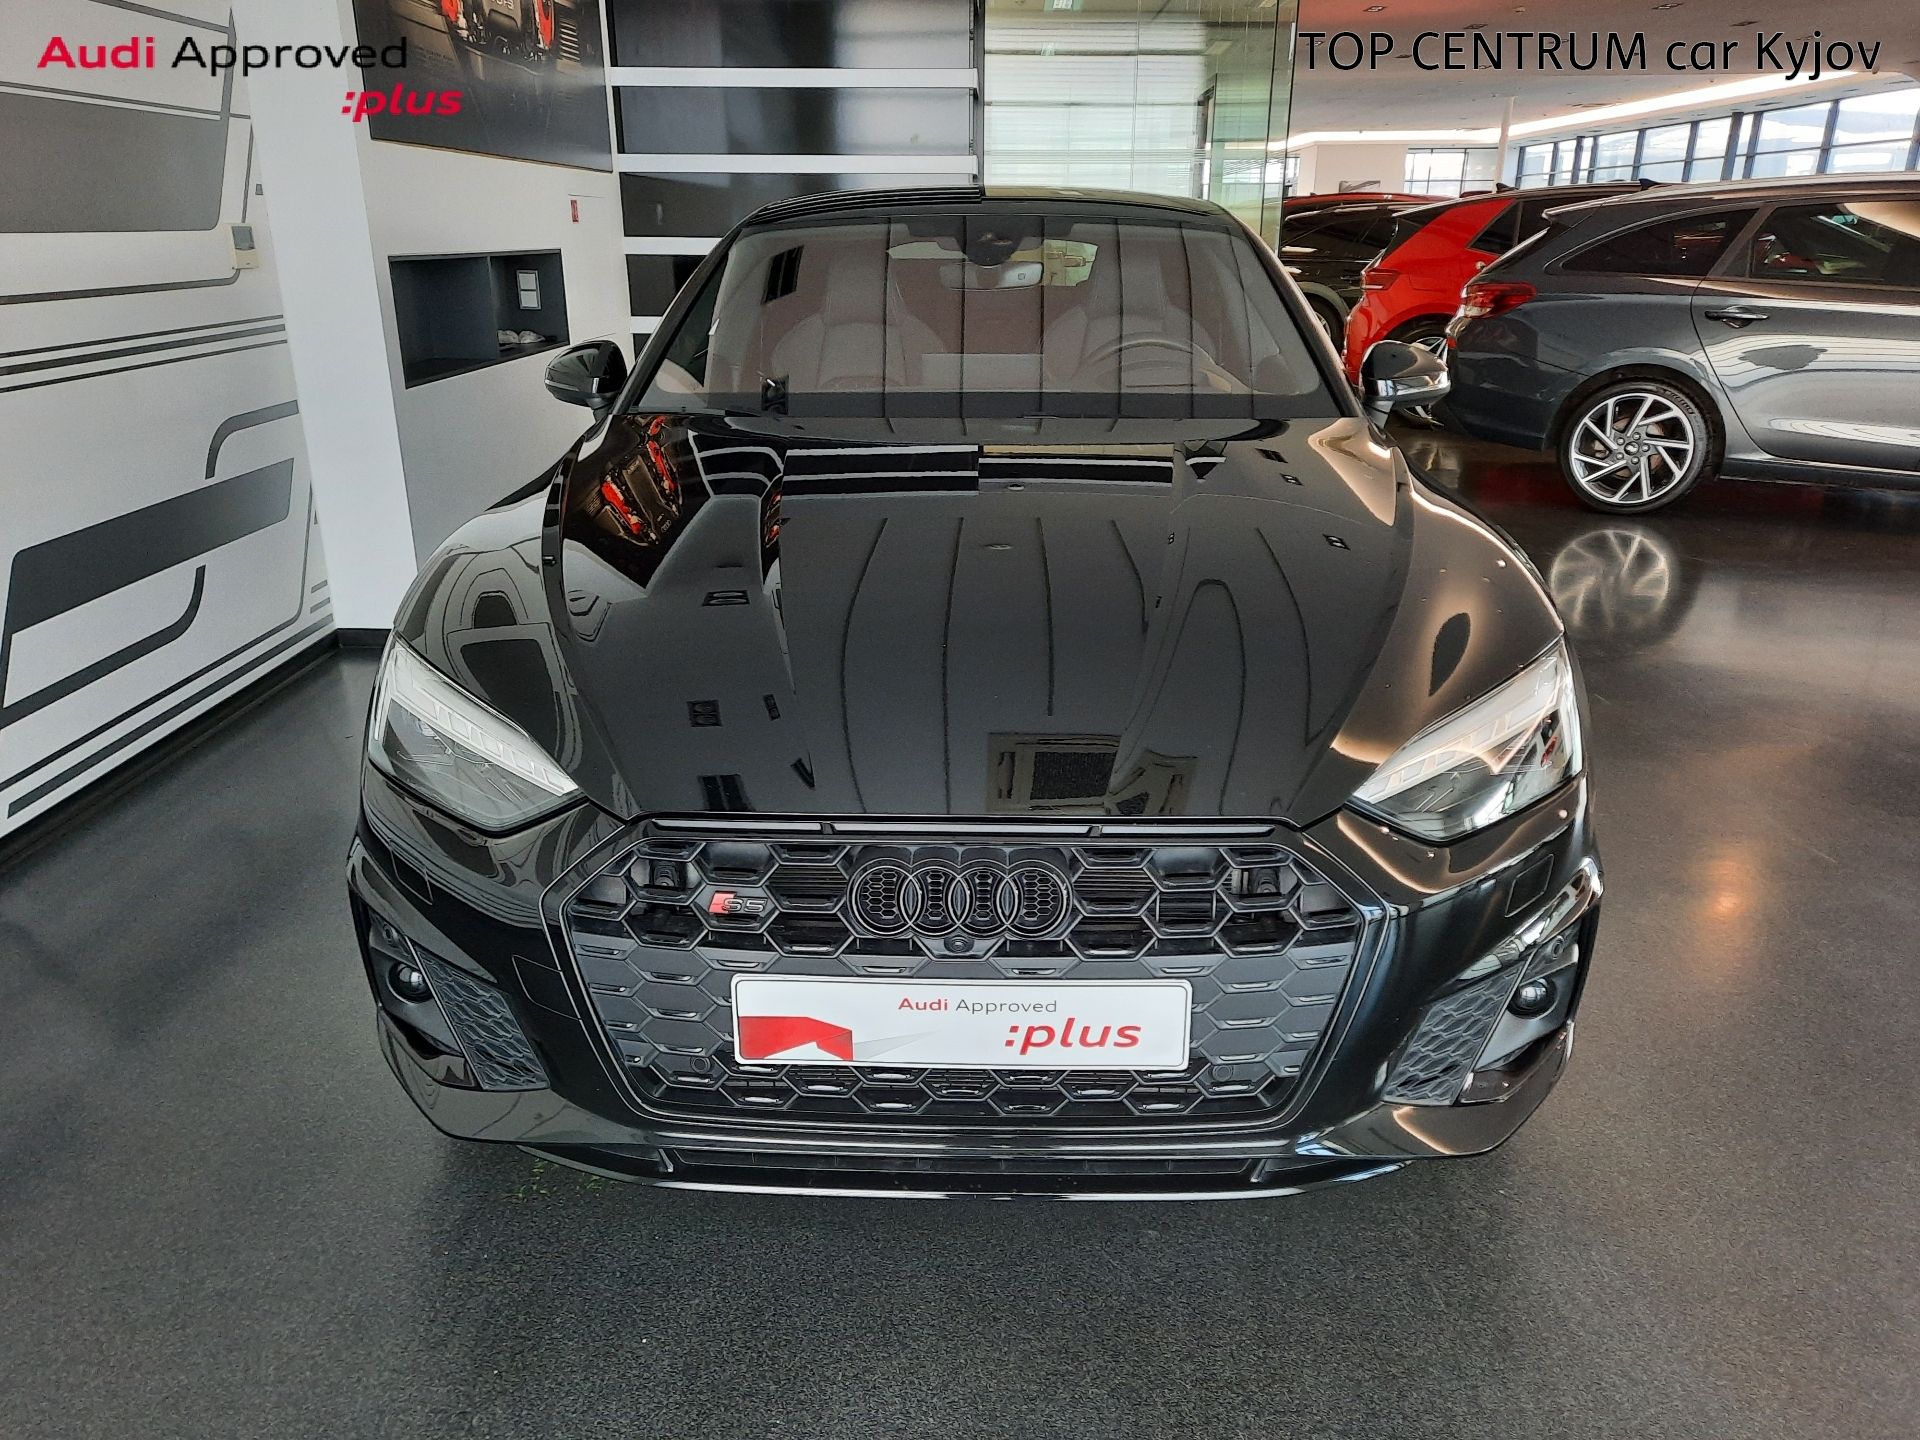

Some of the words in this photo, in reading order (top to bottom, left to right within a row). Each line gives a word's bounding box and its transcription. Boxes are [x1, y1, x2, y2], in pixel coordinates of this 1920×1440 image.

[898, 997, 948, 1011] Audi
[955, 998, 1057, 1015] Approved
[1004, 1017, 1142, 1056] :plus
